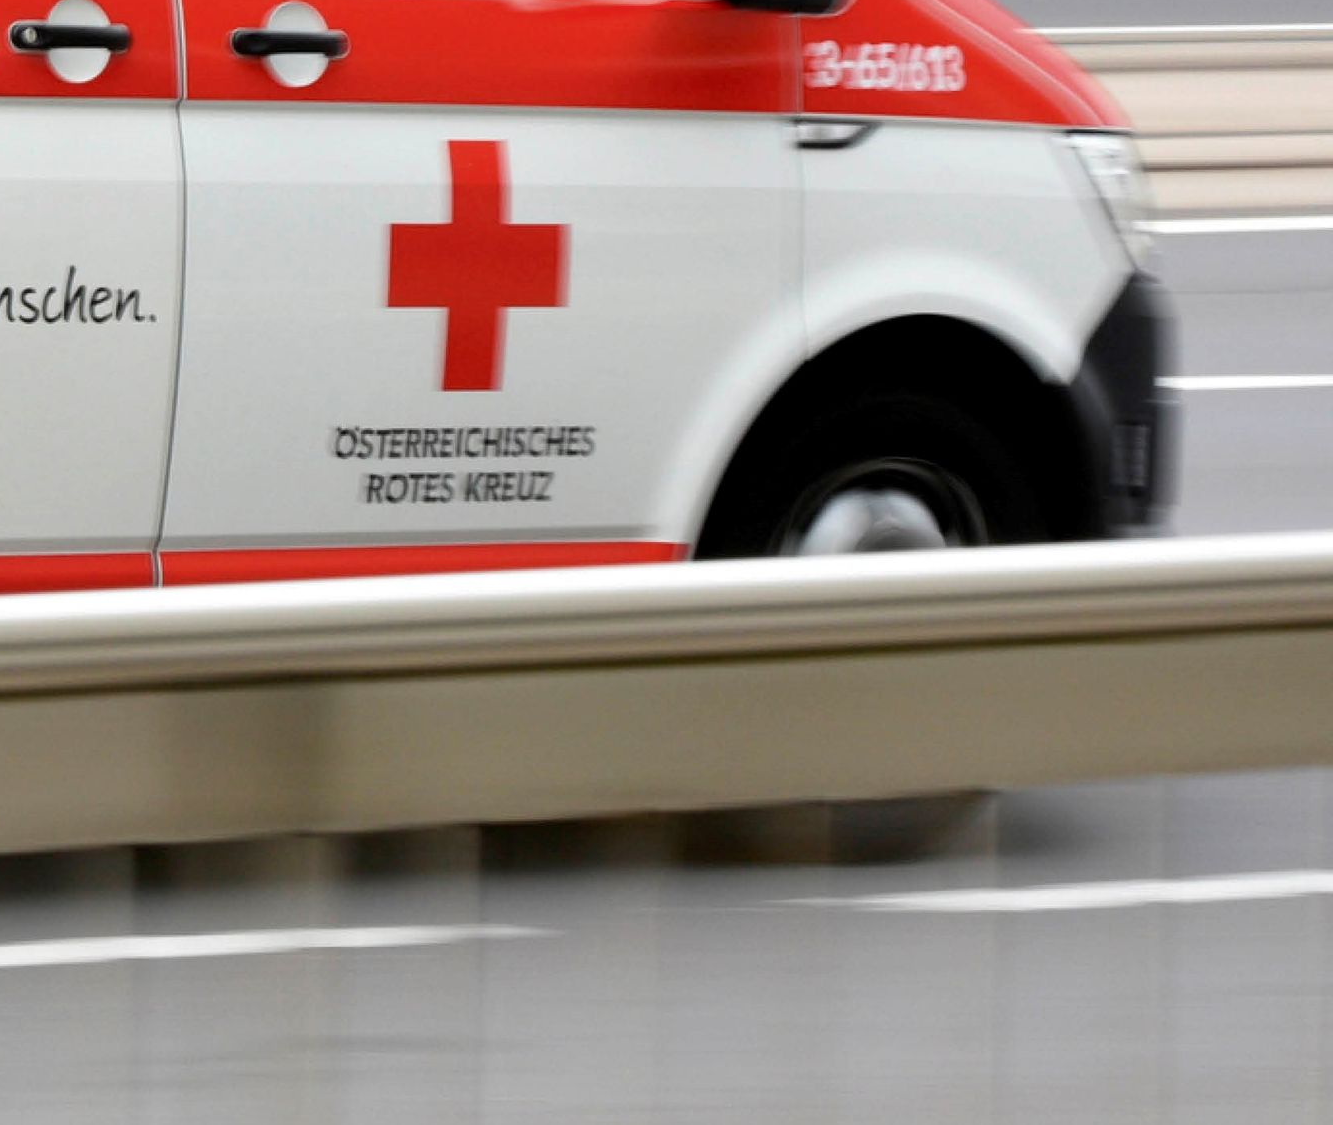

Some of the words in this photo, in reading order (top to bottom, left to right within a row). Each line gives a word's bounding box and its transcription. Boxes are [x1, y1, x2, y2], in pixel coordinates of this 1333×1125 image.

[333, 426, 596, 459] ÖSTERREICHISCHES
[364, 474, 455, 503] ROTES
[463, 471, 555, 502] KREUZ
